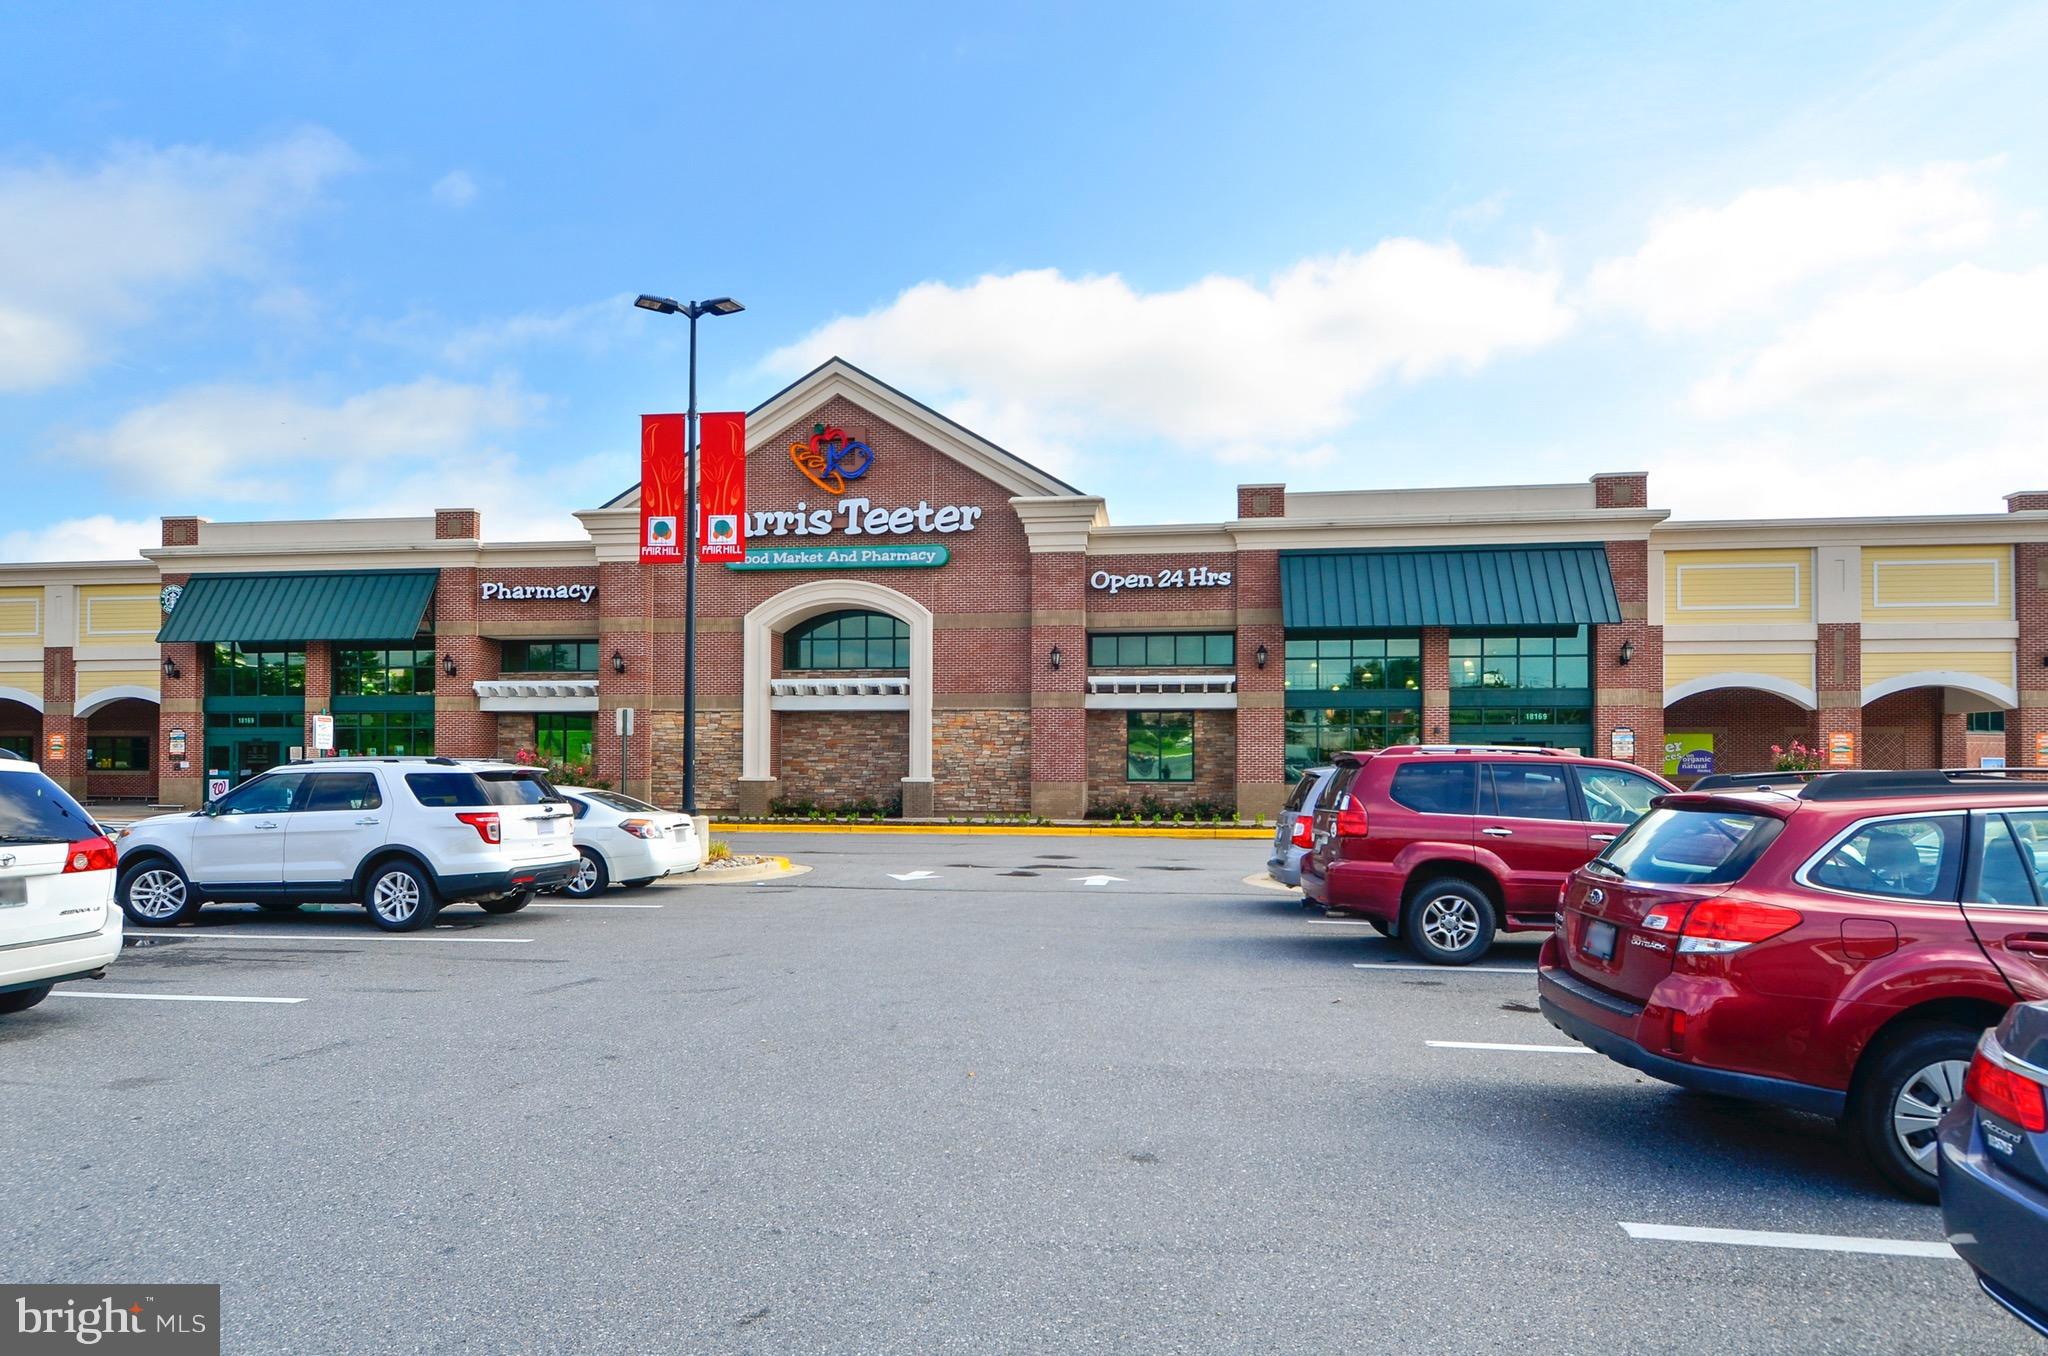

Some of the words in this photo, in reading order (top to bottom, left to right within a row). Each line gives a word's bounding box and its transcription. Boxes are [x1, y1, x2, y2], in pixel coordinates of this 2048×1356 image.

[744, 502, 833, 537] rris
[838, 498, 981, 535] Teeter
[641, 546, 661, 556] FAIR
[661, 546, 681, 556] HILL
[701, 545, 722, 555] FAIR
[723, 545, 742, 555] HILL
[744, 552, 769, 564] ood
[773, 551, 824, 564] Market
[827, 550, 857, 563] And
[861, 550, 936, 563] Pharmacy
[1090, 570, 1155, 594] Open
[1157, 569, 1185, 588] 24
[1188, 566, 1231, 587] Hrs
[481, 582, 596, 603] Pharmacy
[1682, 756, 1712, 764] organic
